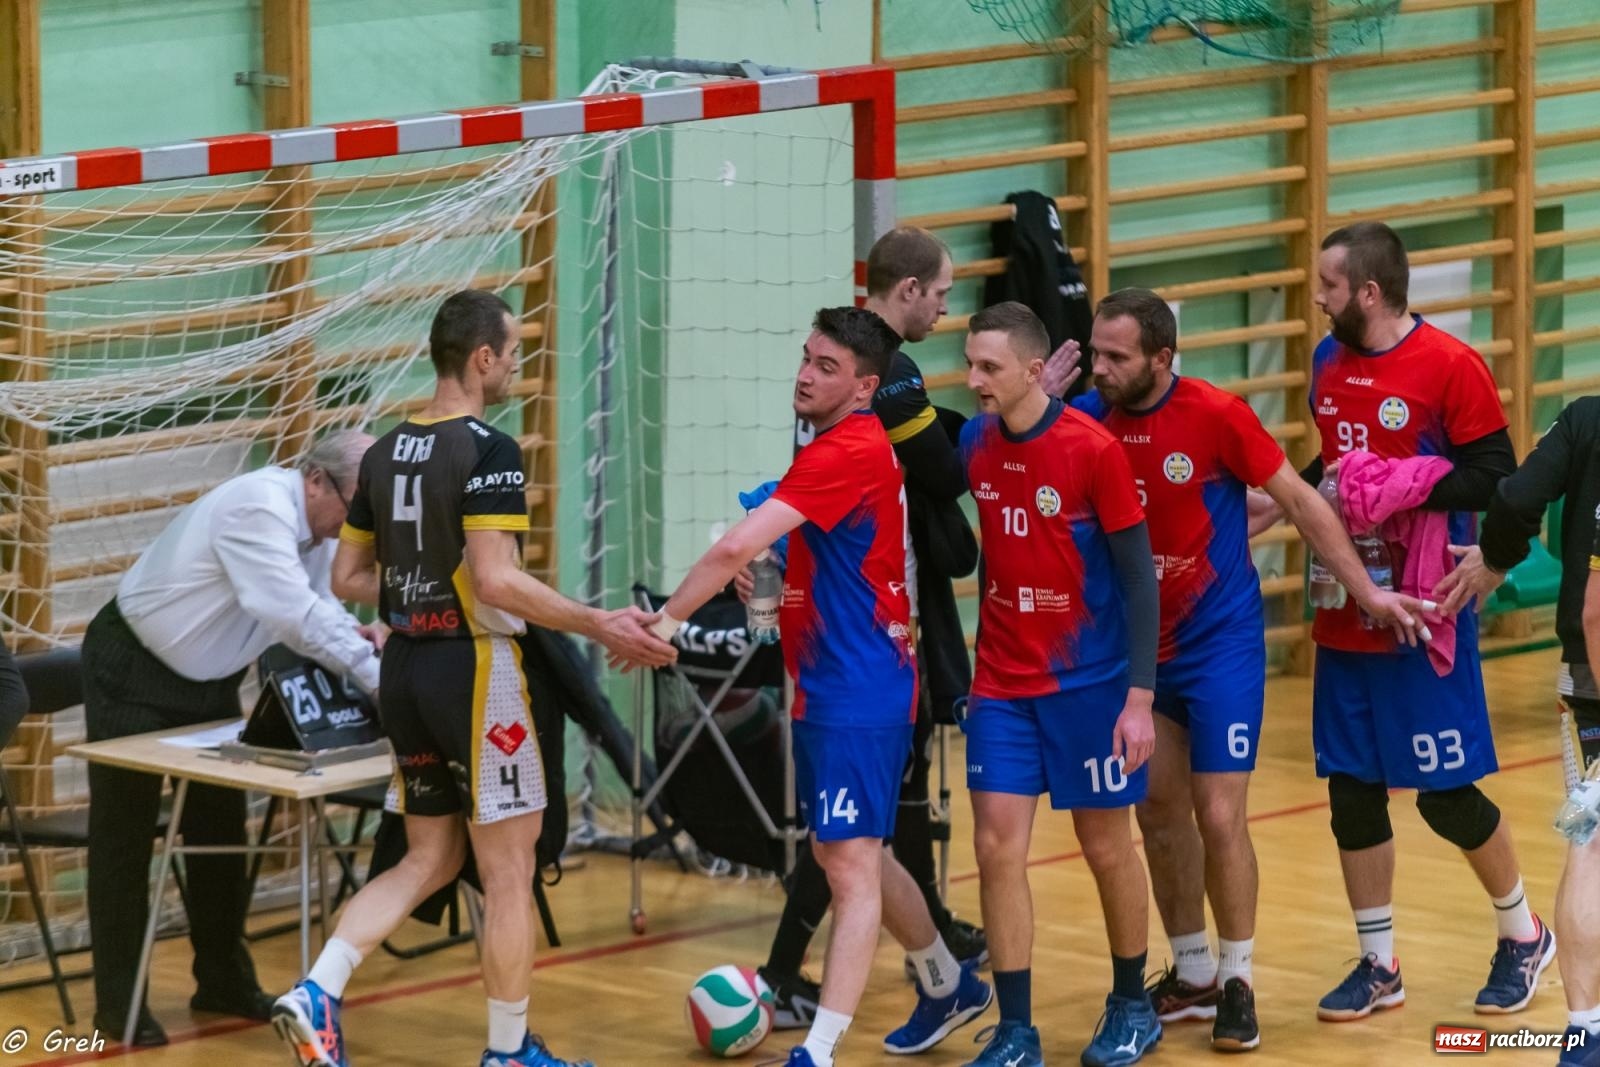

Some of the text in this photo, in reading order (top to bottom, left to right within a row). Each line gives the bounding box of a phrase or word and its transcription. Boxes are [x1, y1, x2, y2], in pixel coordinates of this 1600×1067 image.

[14, 167, 56, 190] sport
[1345, 376, 1374, 387] ALLSIX
[1122, 434, 1151, 444] ALLSIX
[1337, 420, 1369, 453] 93
[1003, 461, 1026, 473] ALLSIX
[974, 489, 1000, 501] VOLLEY
[980, 482, 992, 491] PV
[392, 474, 424, 551] 4
[1001, 506, 1029, 537] 10
[281, 674, 322, 725] 25
[1227, 723, 1250, 759] 6
[1412, 728, 1465, 773] 93
[500, 764, 521, 798] 4
[1084, 754, 1128, 793] 10
[819, 787, 859, 825] 14
